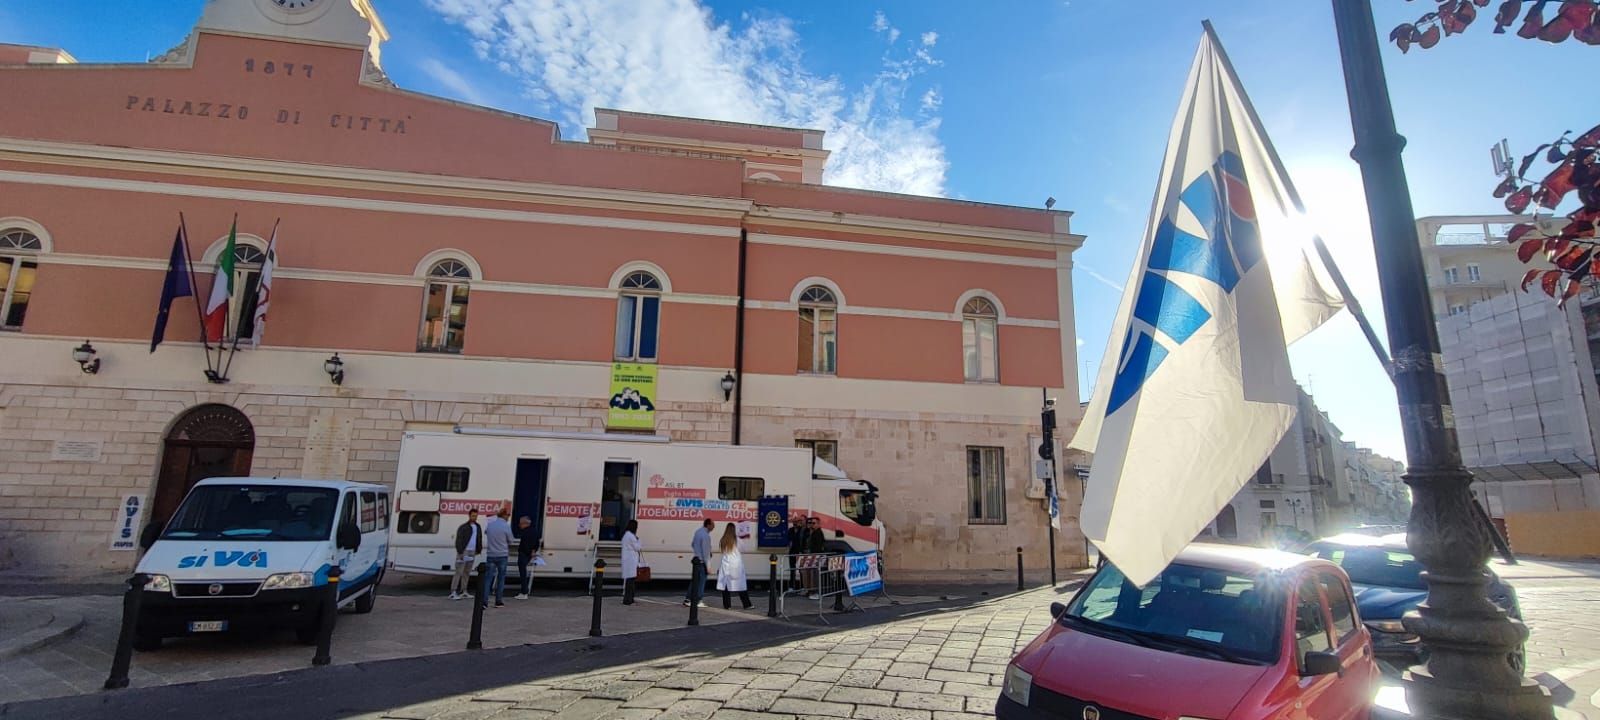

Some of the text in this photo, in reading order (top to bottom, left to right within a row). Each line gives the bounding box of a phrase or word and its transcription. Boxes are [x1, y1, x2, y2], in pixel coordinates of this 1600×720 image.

[245, 58, 313, 78] 1877
[126, 95, 249, 119] PALAZZO
[277, 109, 300, 124] DI
[440, 502, 501, 512] OEMOTECA
[546, 504, 600, 516] OEMOTECA
[676, 499, 703, 508] AVIS
[121, 496, 139, 538] AVIS
